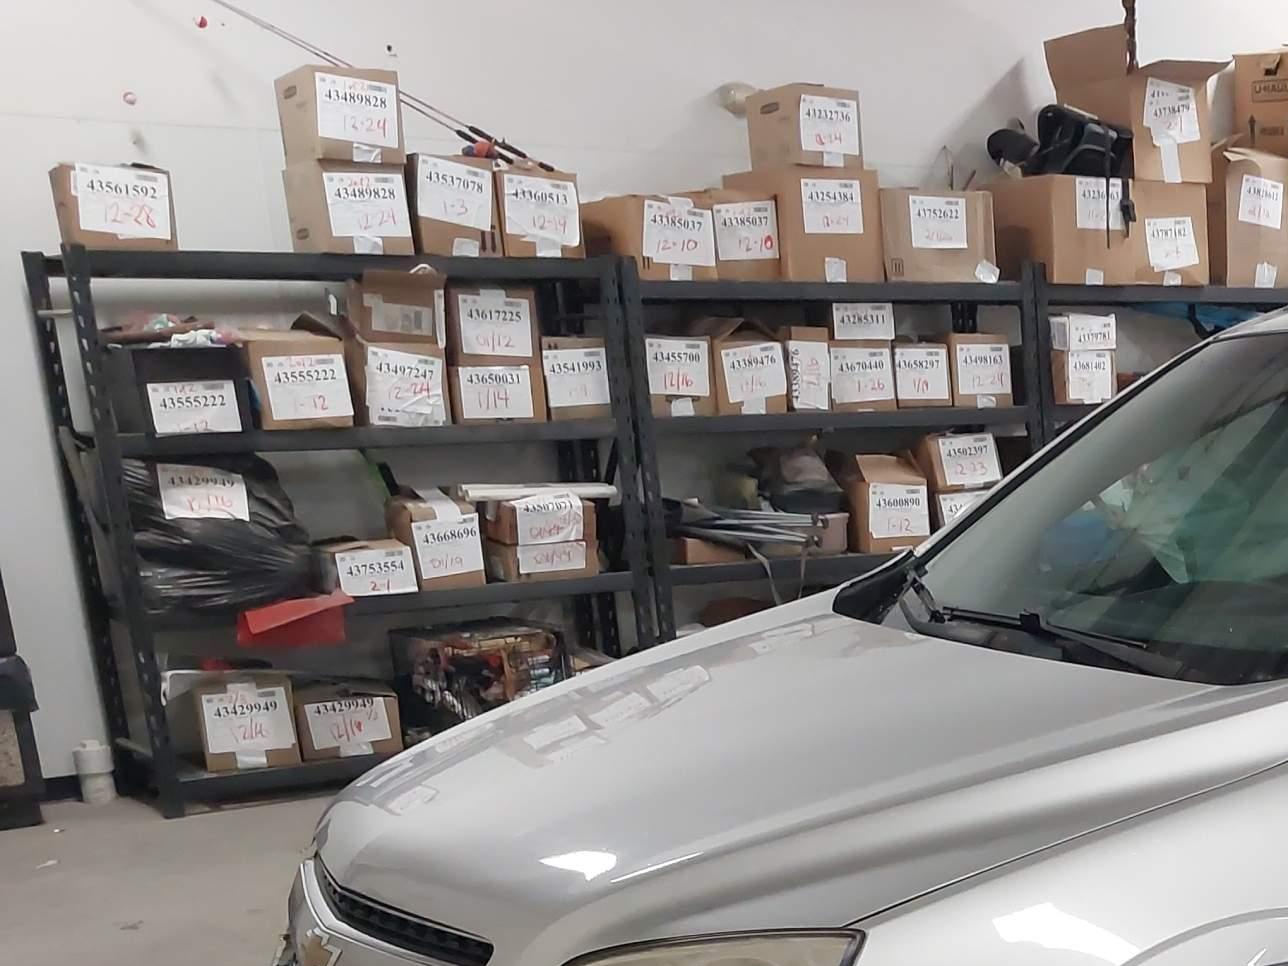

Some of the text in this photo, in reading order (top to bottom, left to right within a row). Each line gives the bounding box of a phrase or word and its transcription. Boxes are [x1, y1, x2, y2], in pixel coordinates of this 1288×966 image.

[324, 89, 387, 109] 43489828
[86, 178, 158, 199] 43561592
[425, 169, 484, 194] 43537078
[334, 187, 396, 201] 43489828
[1081, 189, 1120, 201] 4323663
[650, 213, 702, 232] 43385037
[721, 216, 768, 228] 43385037
[466, 308, 522, 322] 43617225
[839, 315, 886, 326] 43285311
[652, 351, 701, 363] 43455700
[730, 355, 776, 371] 43389476
[962, 354, 1003, 366] 43498163
[376, 362, 435, 379] 43497247
[550, 360, 602, 375] 43541993
[838, 360, 885, 373] 43670440
[274, 368, 336, 384] 43555222
[466, 372, 521, 386] 43650031
[160, 394, 227, 409] 43555222
[875, 496, 921, 509] 43600890
[423, 527, 477, 545] 43668696
[347, 559, 405, 576] 43753554
[214, 701, 278, 719] 43429949
[314, 698, 374, 715] 43429949
